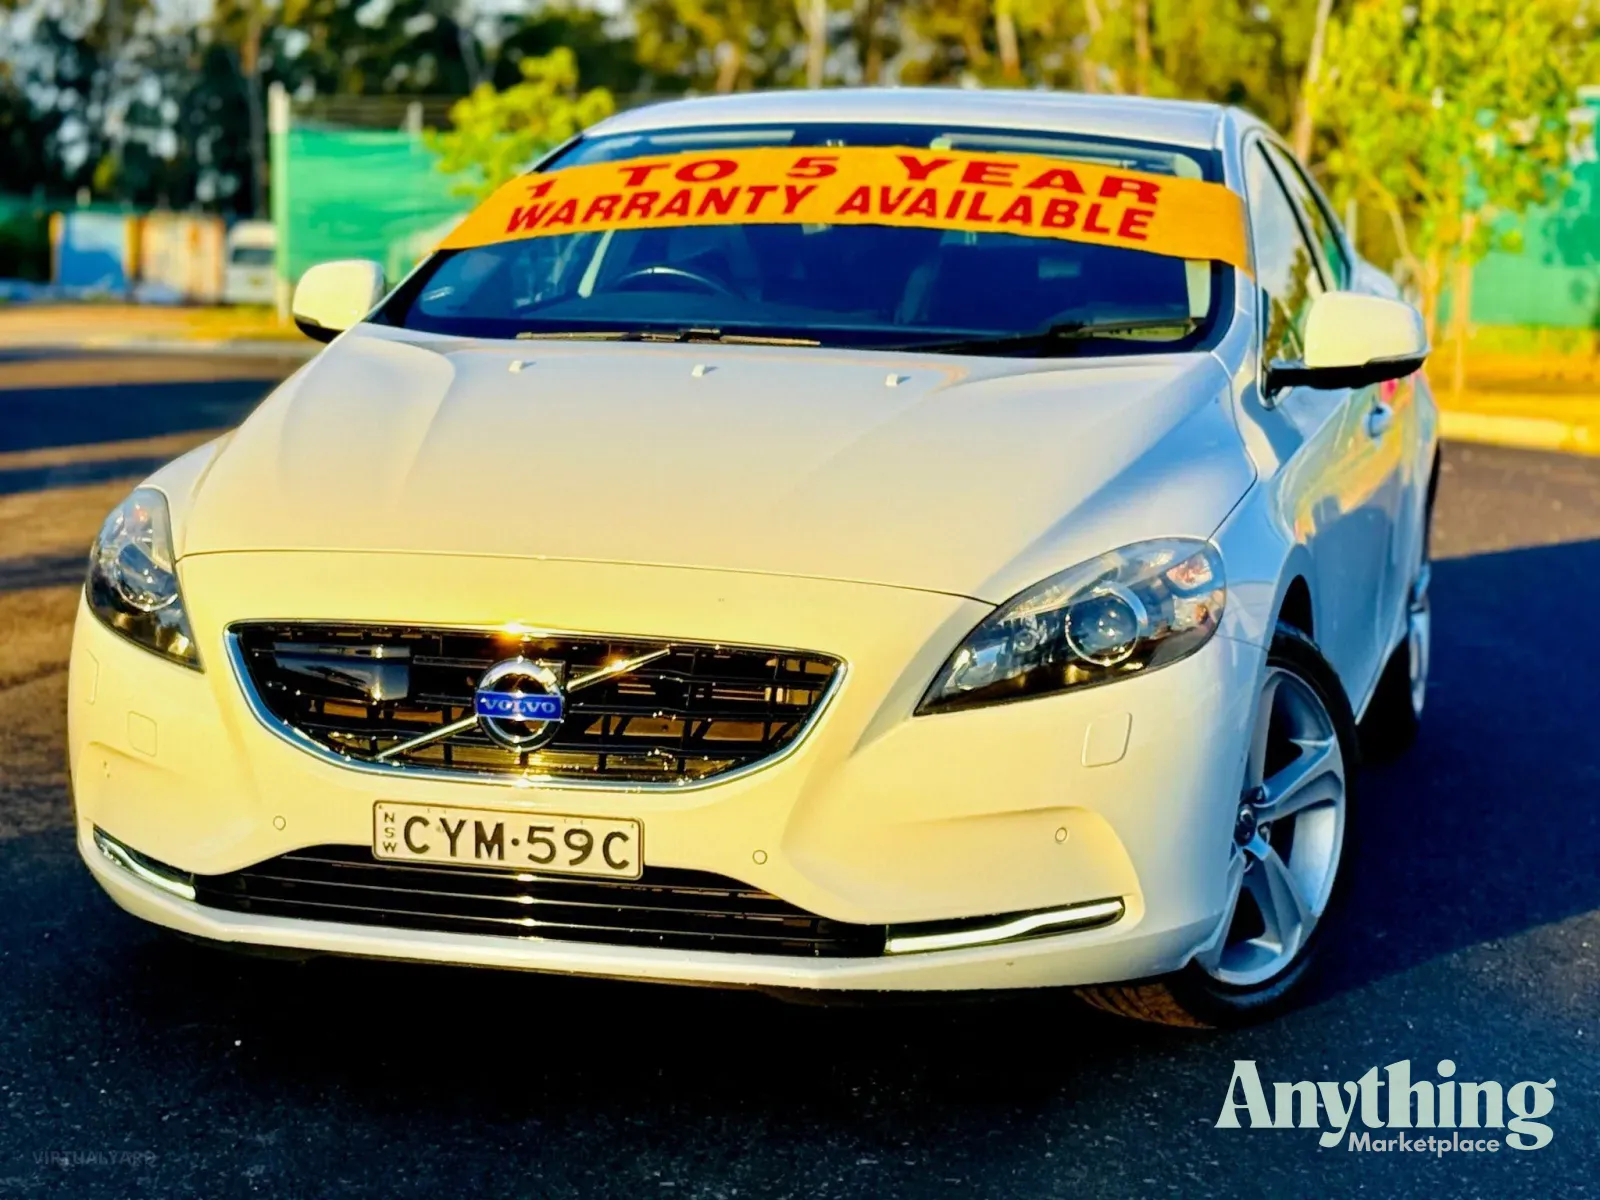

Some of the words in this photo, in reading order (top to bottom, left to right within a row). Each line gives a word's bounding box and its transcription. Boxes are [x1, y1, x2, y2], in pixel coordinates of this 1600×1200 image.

[526, 179, 557, 199] 1
[619, 159, 738, 188] TO
[786, 156, 840, 180] 5
[896, 155, 1161, 205] YEAR
[505, 184, 819, 233] WARRANTY
[835, 186, 1155, 240] AVAILABLE
[480, 698, 556, 714] VOLVO
[384, 812, 398, 854] NSW
